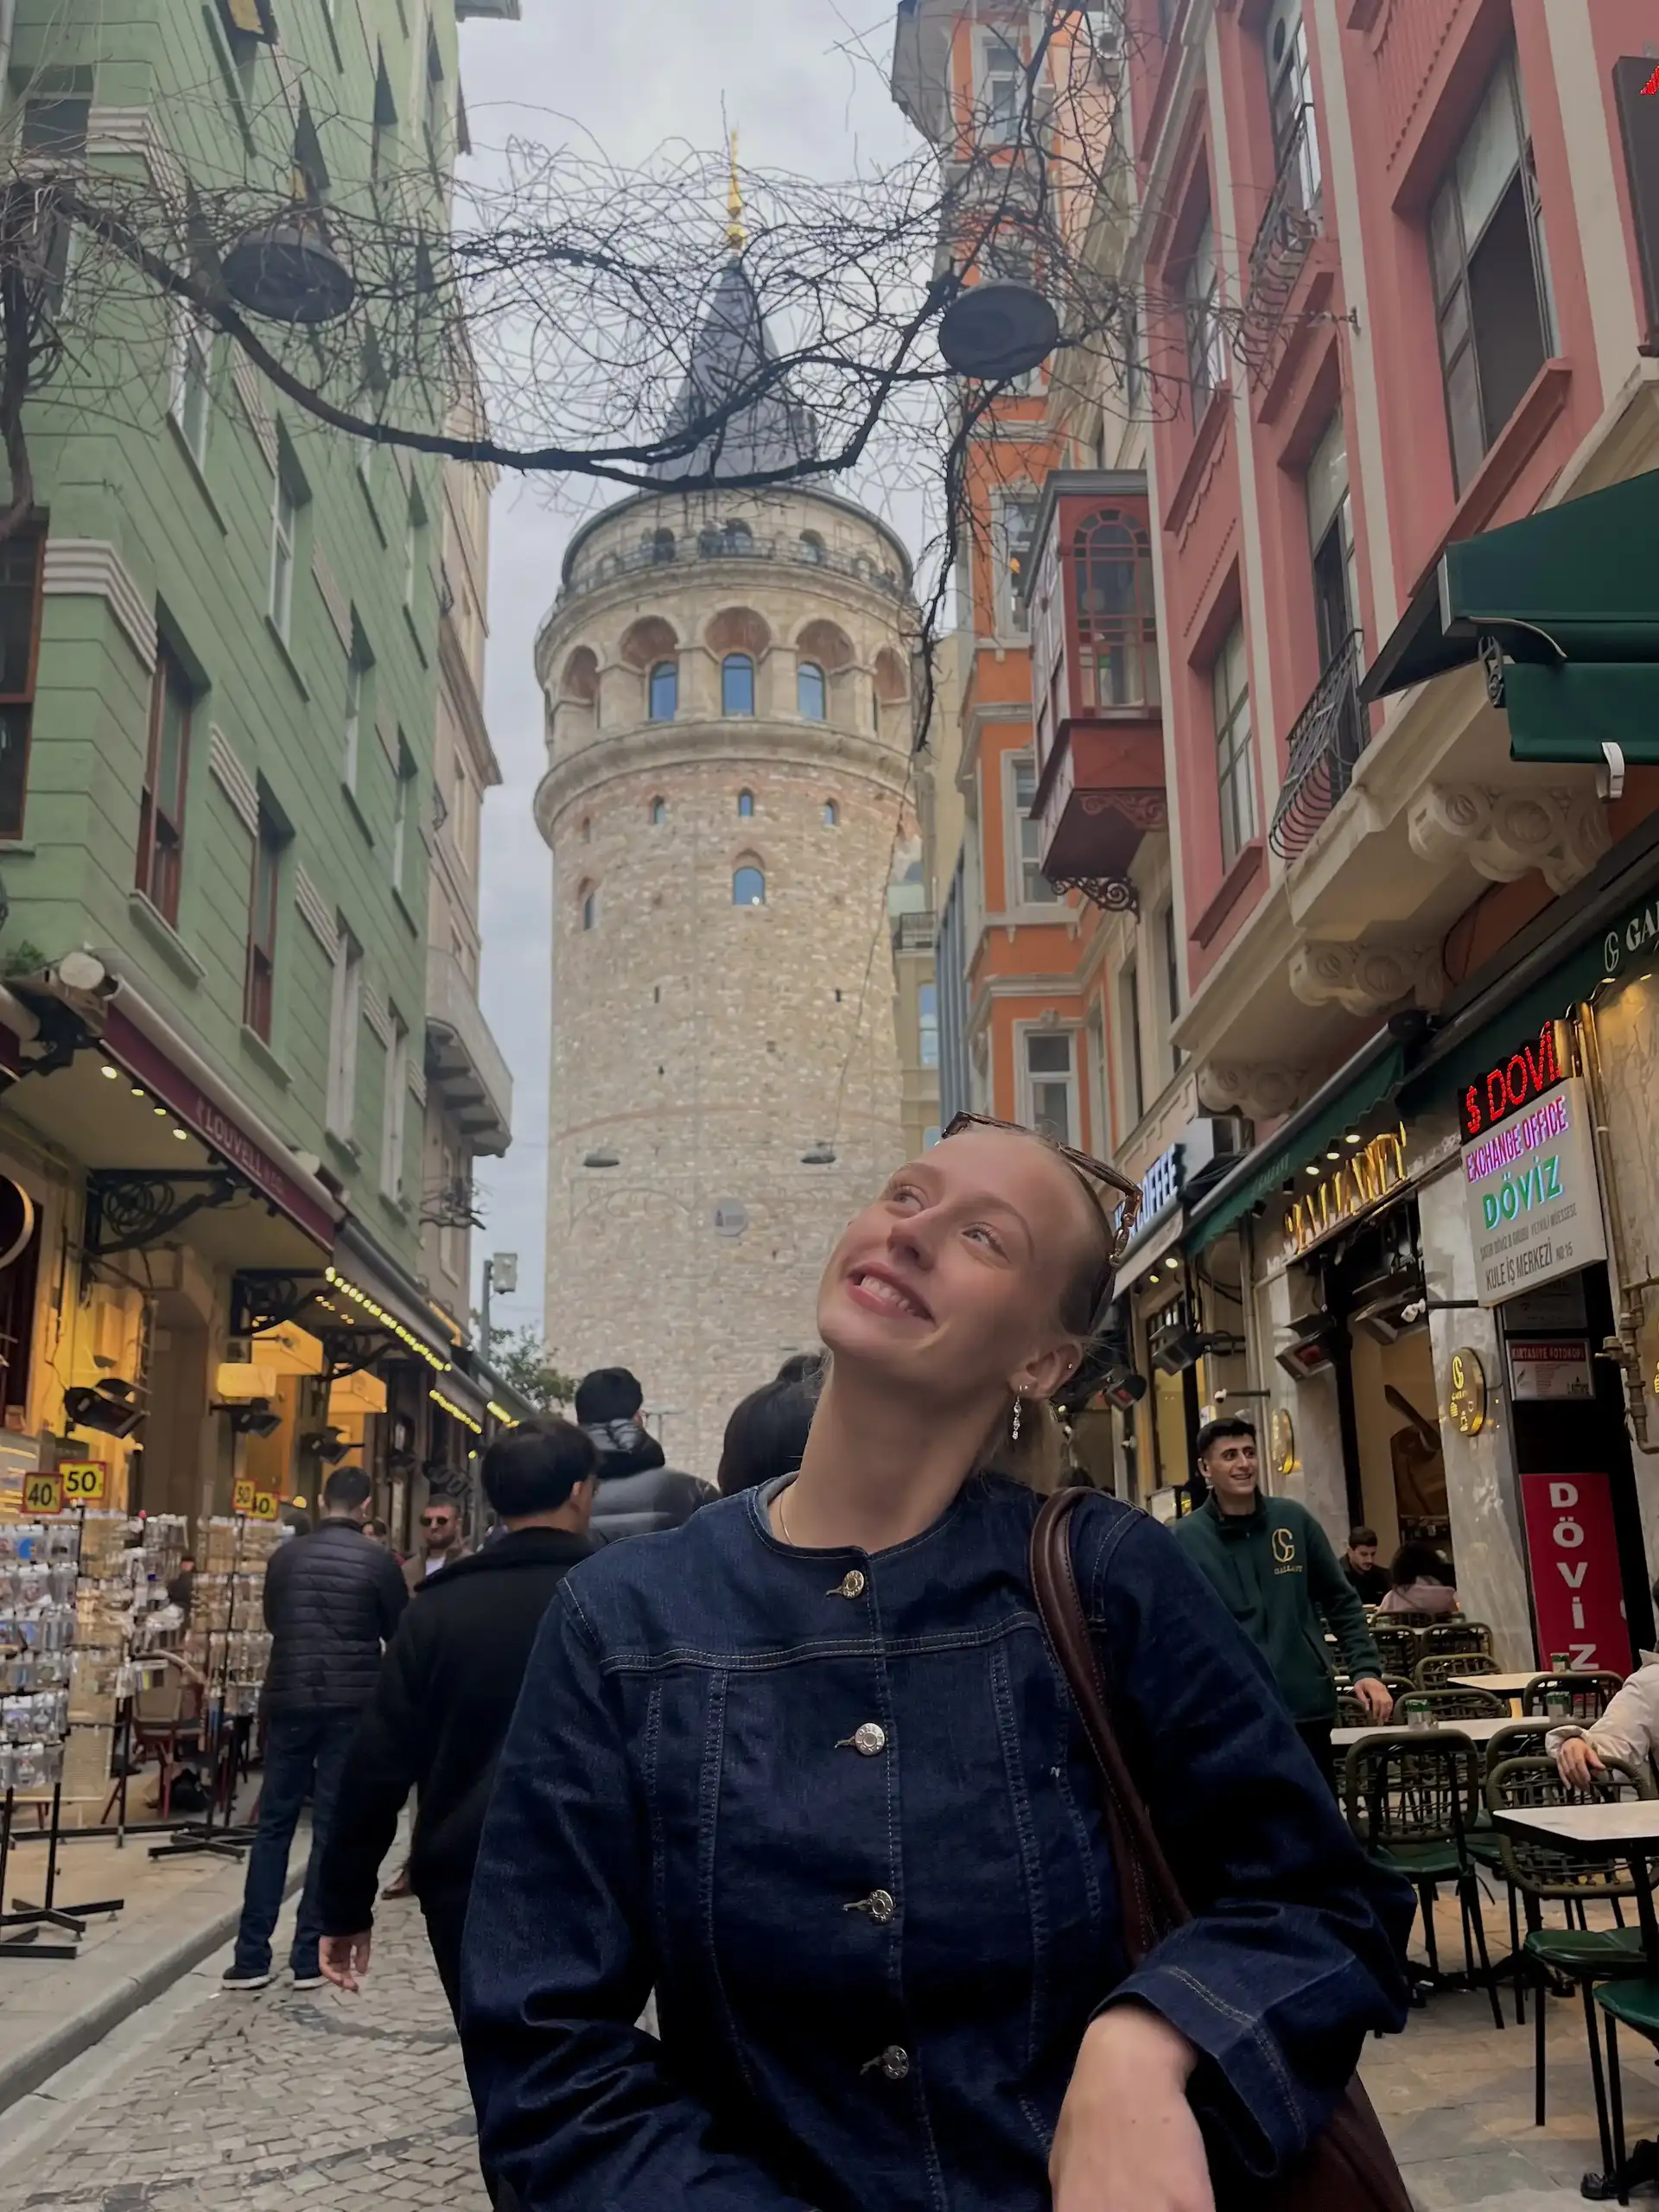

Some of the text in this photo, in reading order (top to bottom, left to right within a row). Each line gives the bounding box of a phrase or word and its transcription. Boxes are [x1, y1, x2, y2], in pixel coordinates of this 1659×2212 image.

[1465, 1095, 1569, 1184] EXCHANGE OFFICE
[1483, 1154, 1564, 1230] DÖVİZ
[1485, 1264, 1506, 1292] KULE
[1506, 1255, 1516, 1286] İŞ
[1516, 1237, 1554, 1279] MERKEZİ
[28, 1483, 52, 1506] 40
[67, 1471, 96, 1492] 50
[1549, 1482, 1599, 1671] DÖVİZ
